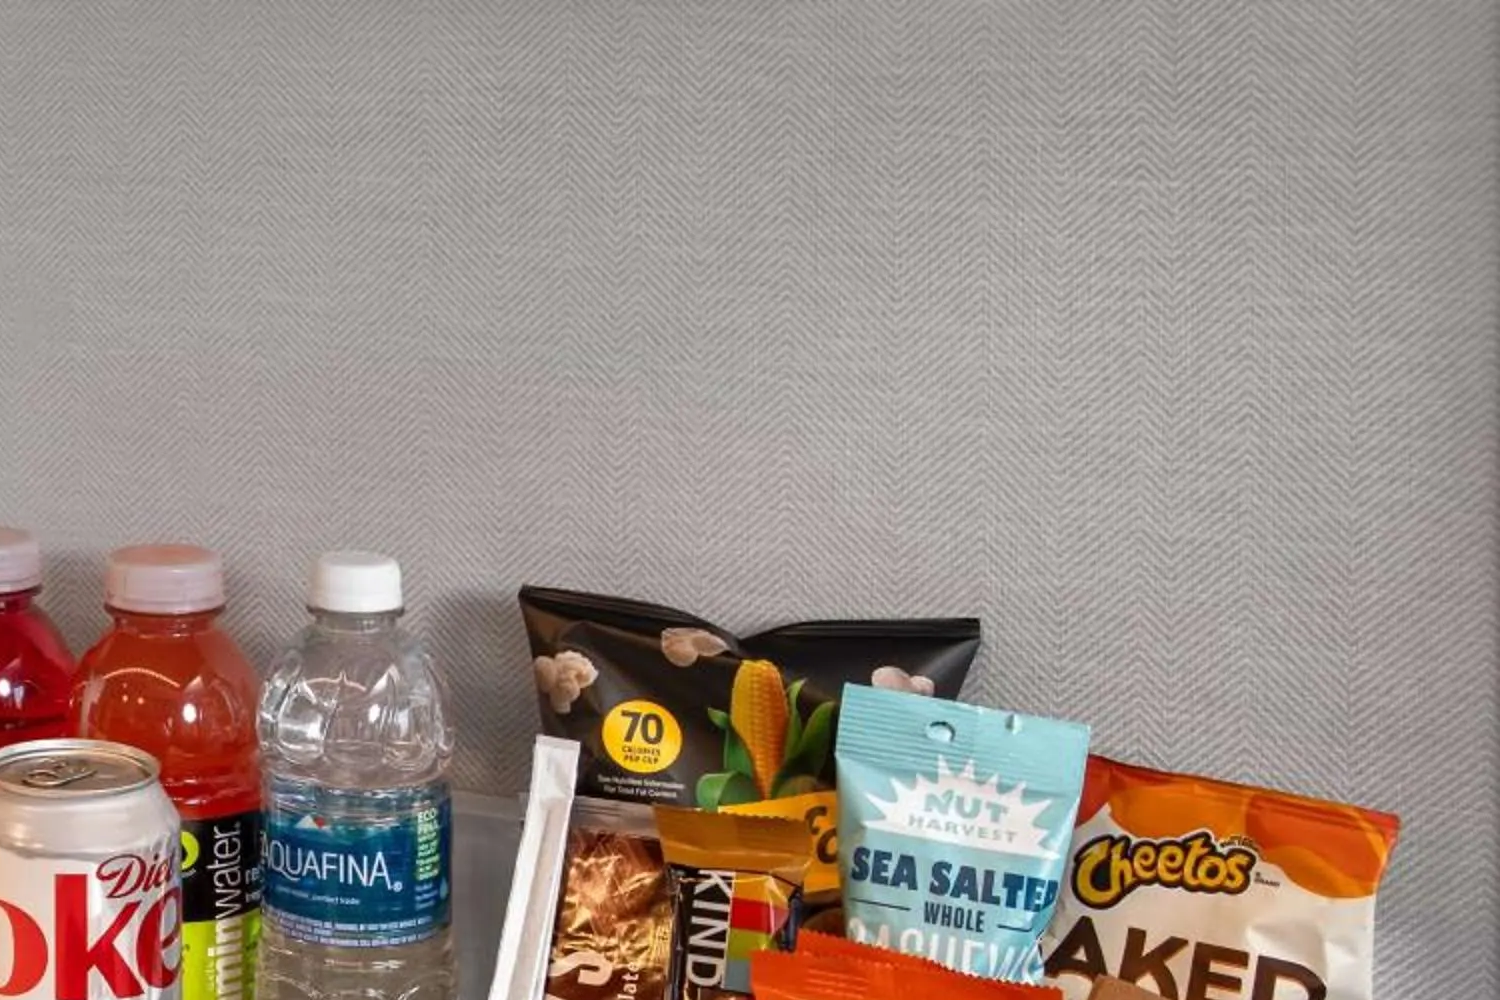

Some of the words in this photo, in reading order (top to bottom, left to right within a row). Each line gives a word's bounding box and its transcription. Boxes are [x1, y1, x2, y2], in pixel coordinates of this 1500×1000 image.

[621, 709, 664, 745] 70
[924, 789, 1010, 822] NUT
[907, 814, 1019, 844] HARVEST
[851, 846, 918, 891] SEA
[1073, 834, 1254, 908] Cheetos
[685, 869, 735, 988] KIND
[924, 901, 986, 933] WHOLE
